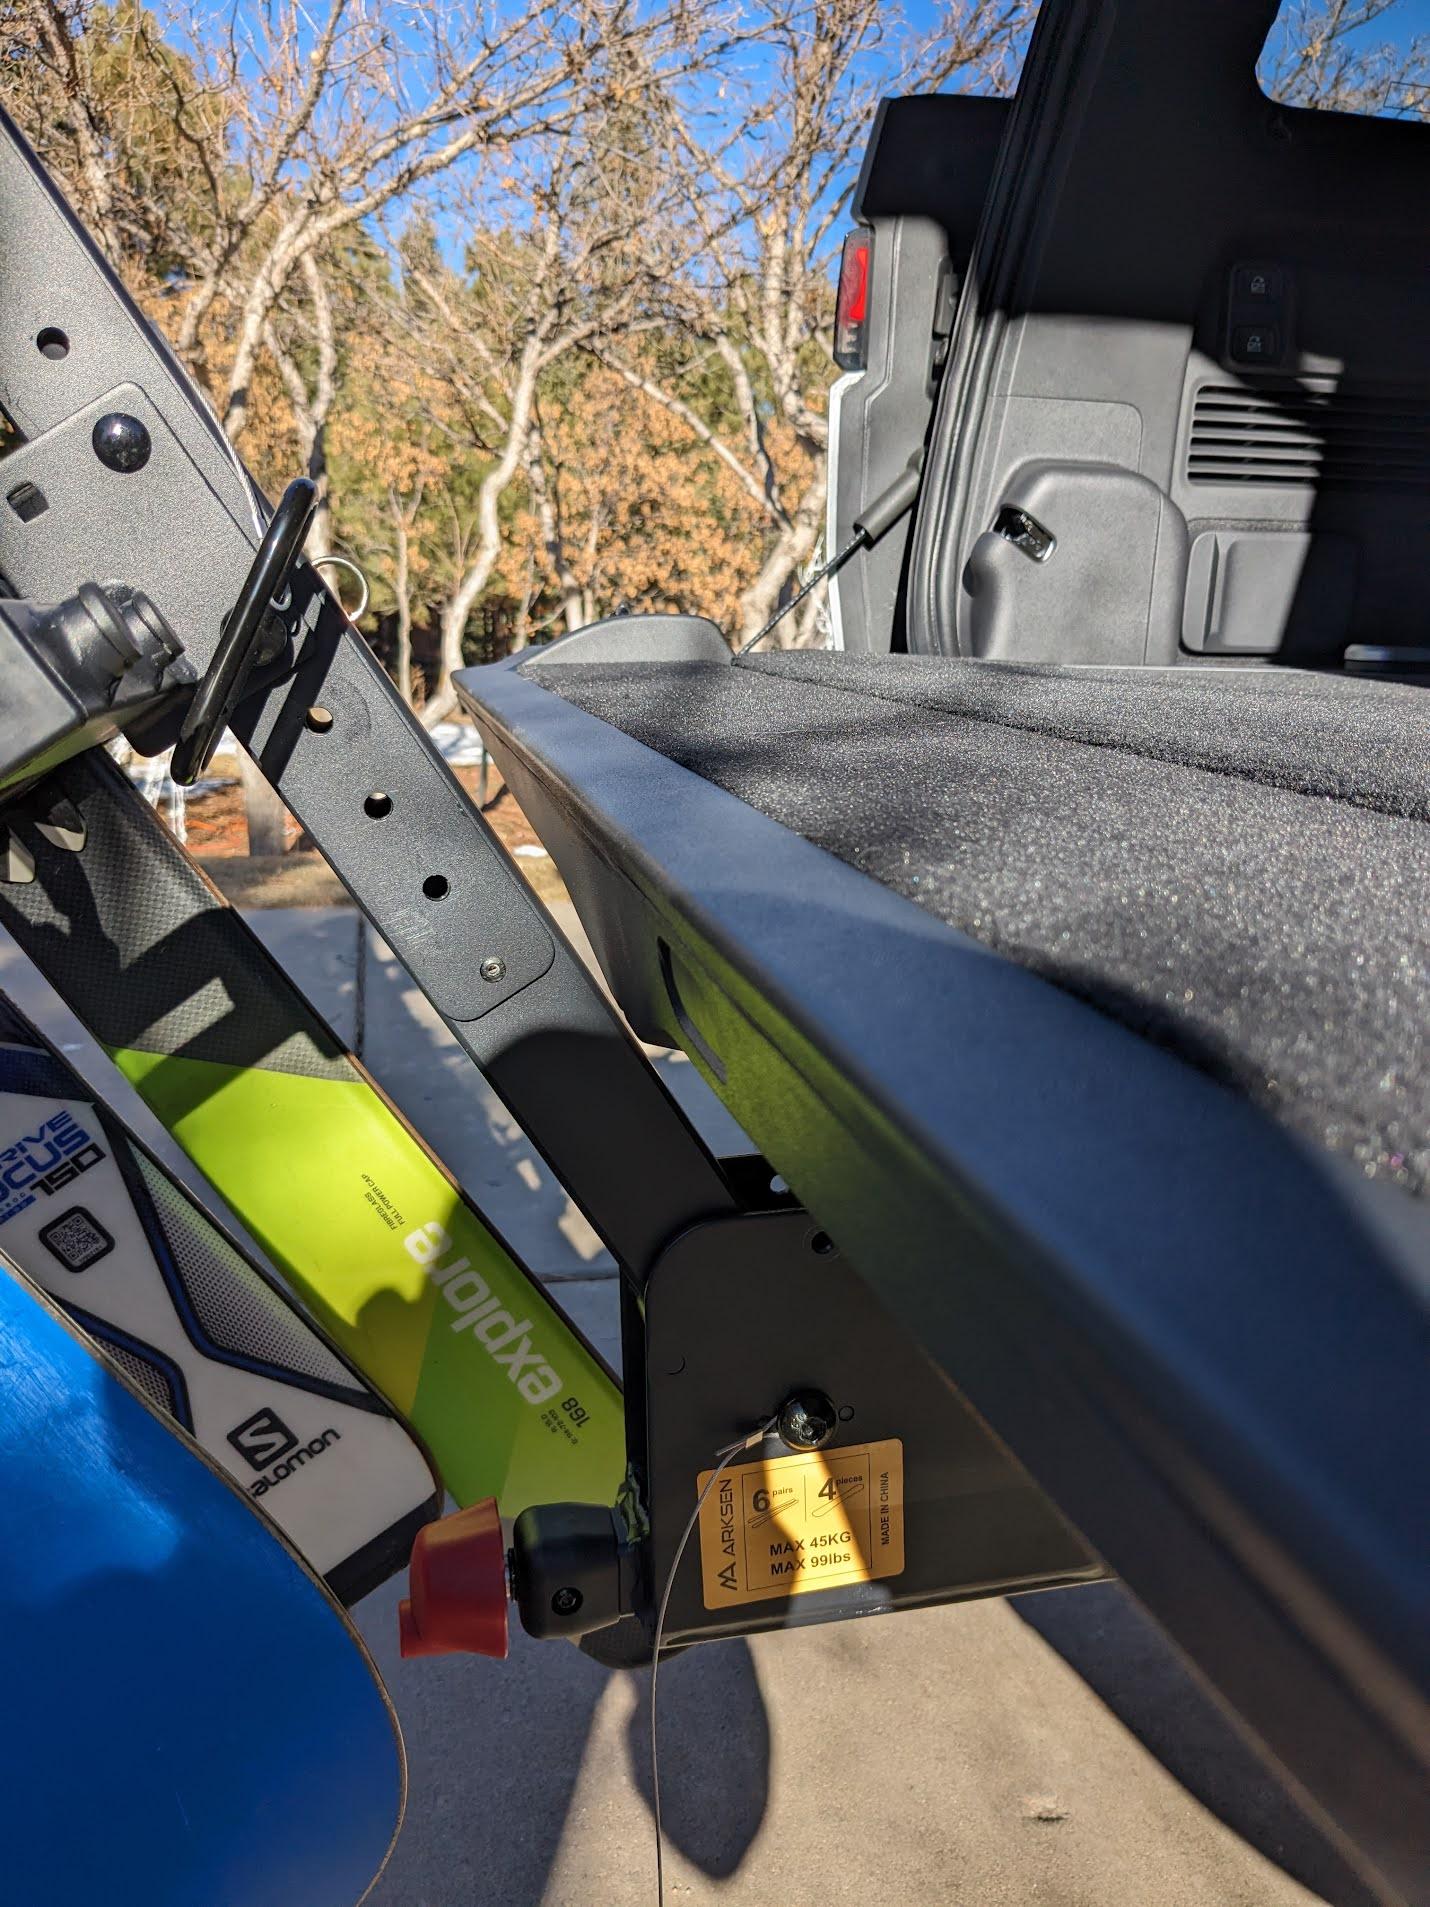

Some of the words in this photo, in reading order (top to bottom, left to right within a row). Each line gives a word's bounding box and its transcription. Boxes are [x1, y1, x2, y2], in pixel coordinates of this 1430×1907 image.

[29, 1142, 106, 1196] 150
[361, 1174, 376, 1187] CAP
[364, 1192, 398, 1231] FIBREGLASS
[372, 1186, 393, 1210] POWER
[391, 1208, 406, 1226] FULL
[403, 1220, 564, 1406] explore
[561, 1397, 591, 1428] 168
[752, 1488, 771, 1512] 6
[772, 1486, 793, 1497] pairs
[818, 1477, 837, 1501] 4
[836, 1475, 863, 1487] pieces
[879, 1471, 889, 1504] CHINA
[719, 1478, 736, 1556] ARKSEN
[880, 1506, 889, 1518] IN
[769, 1539, 805, 1557] MAX
[809, 1530, 851, 1549] 45KG
[880, 1518, 890, 1545] MADE
[771, 1558, 806, 1576] MAX
[810, 1551, 851, 1568] 99lbs
